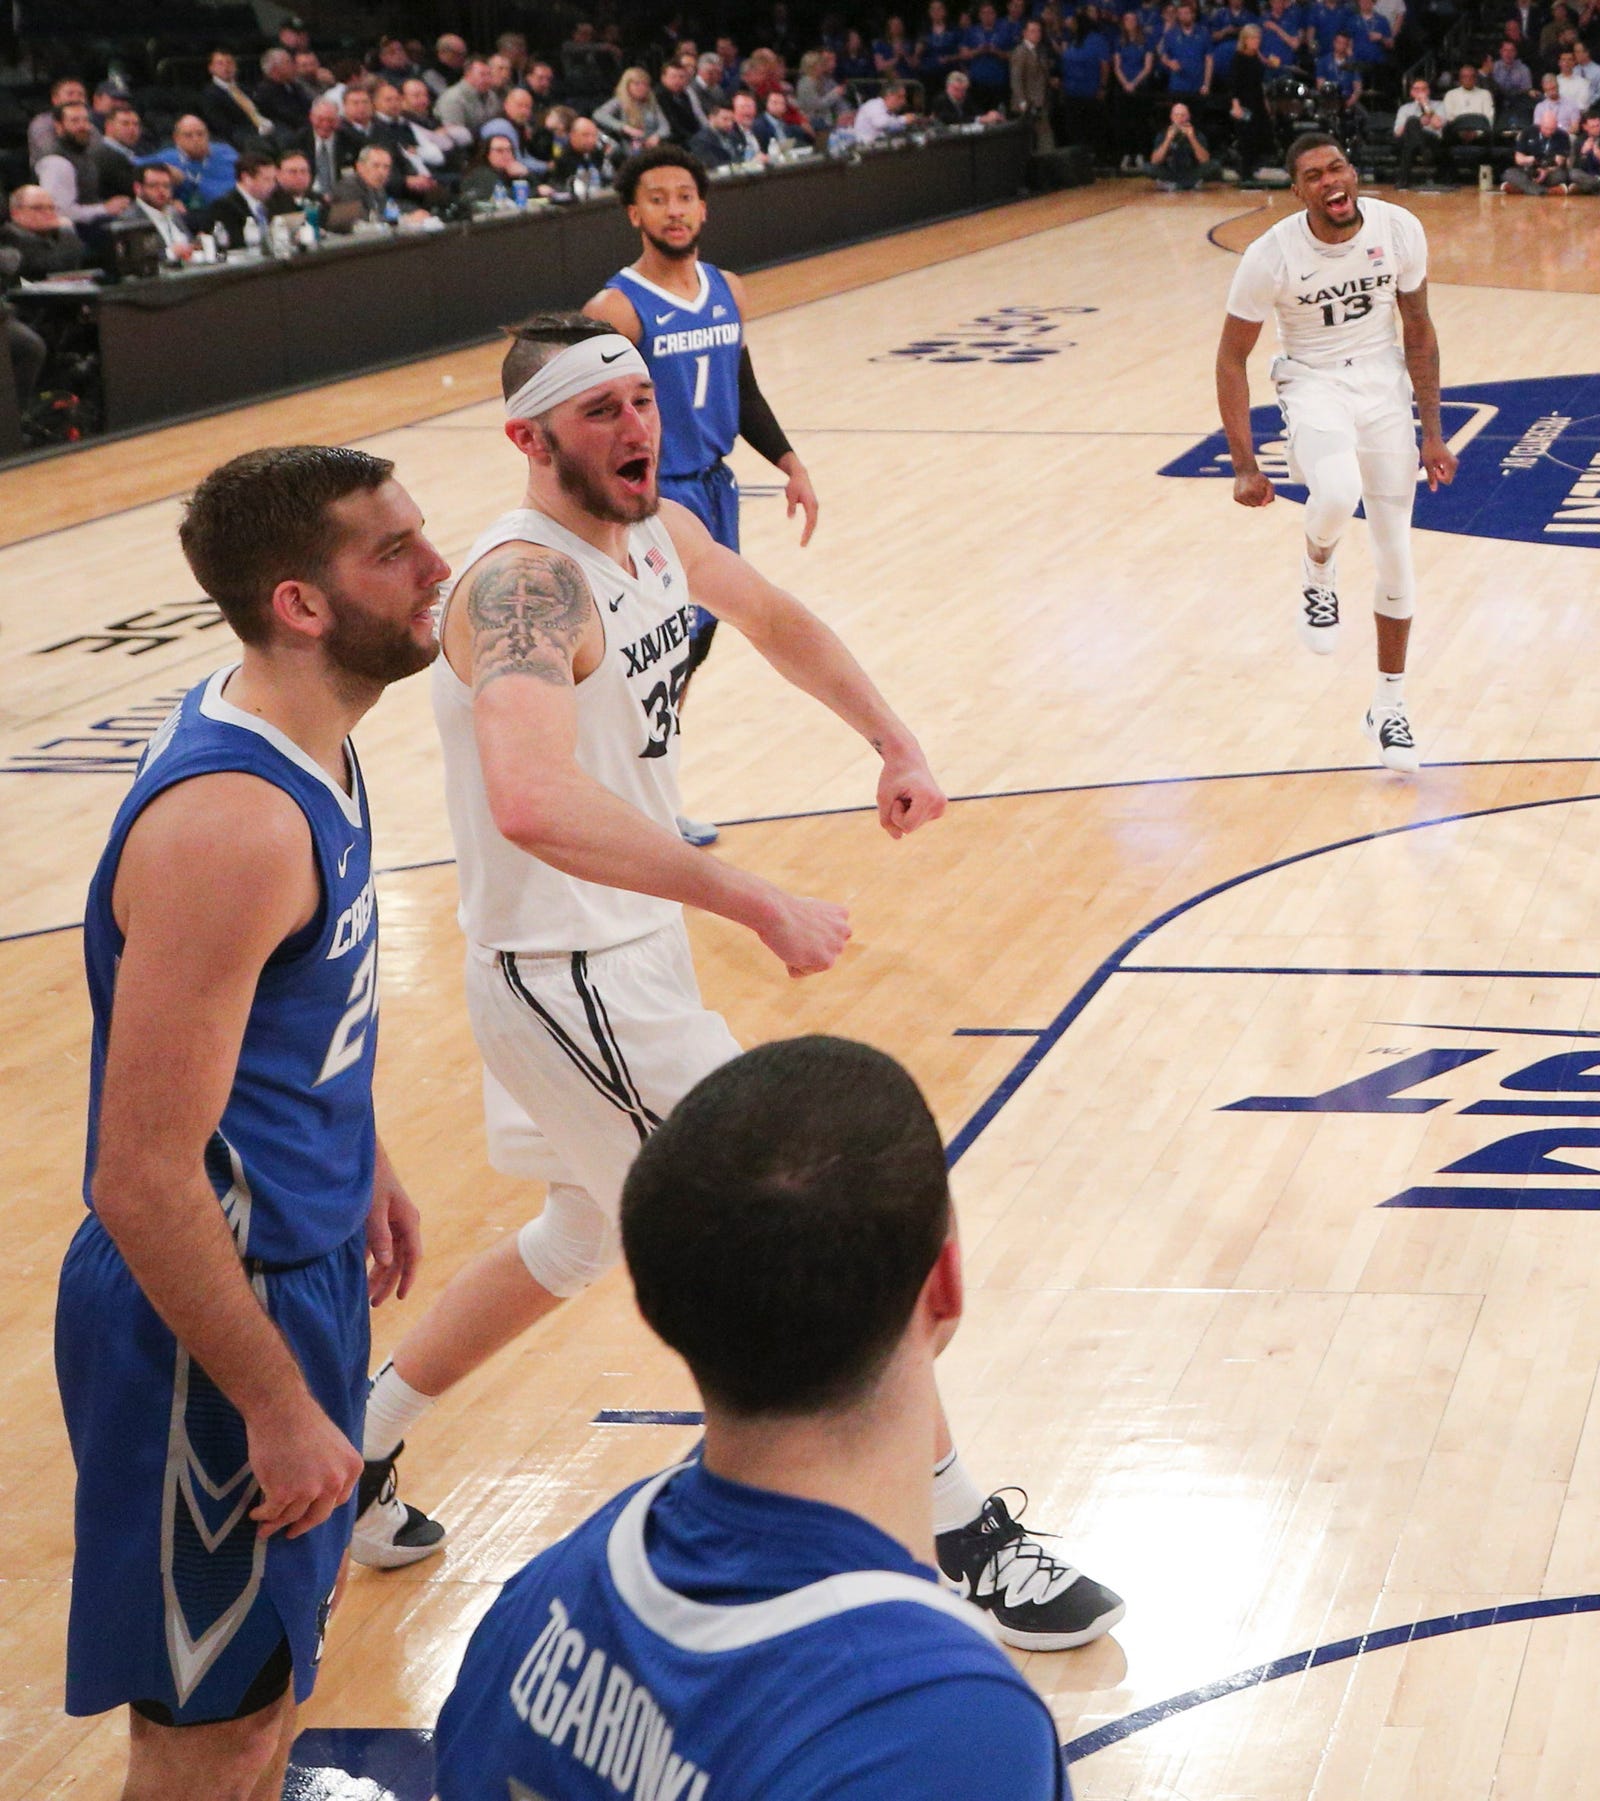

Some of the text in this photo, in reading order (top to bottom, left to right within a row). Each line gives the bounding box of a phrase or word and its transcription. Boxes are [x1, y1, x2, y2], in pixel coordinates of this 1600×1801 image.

[1297, 275, 1391, 305] XAVIER
[1320, 294, 1373, 326] 13
[653, 323, 740, 357] CREIGHTON
[693, 355, 710, 409] 1
